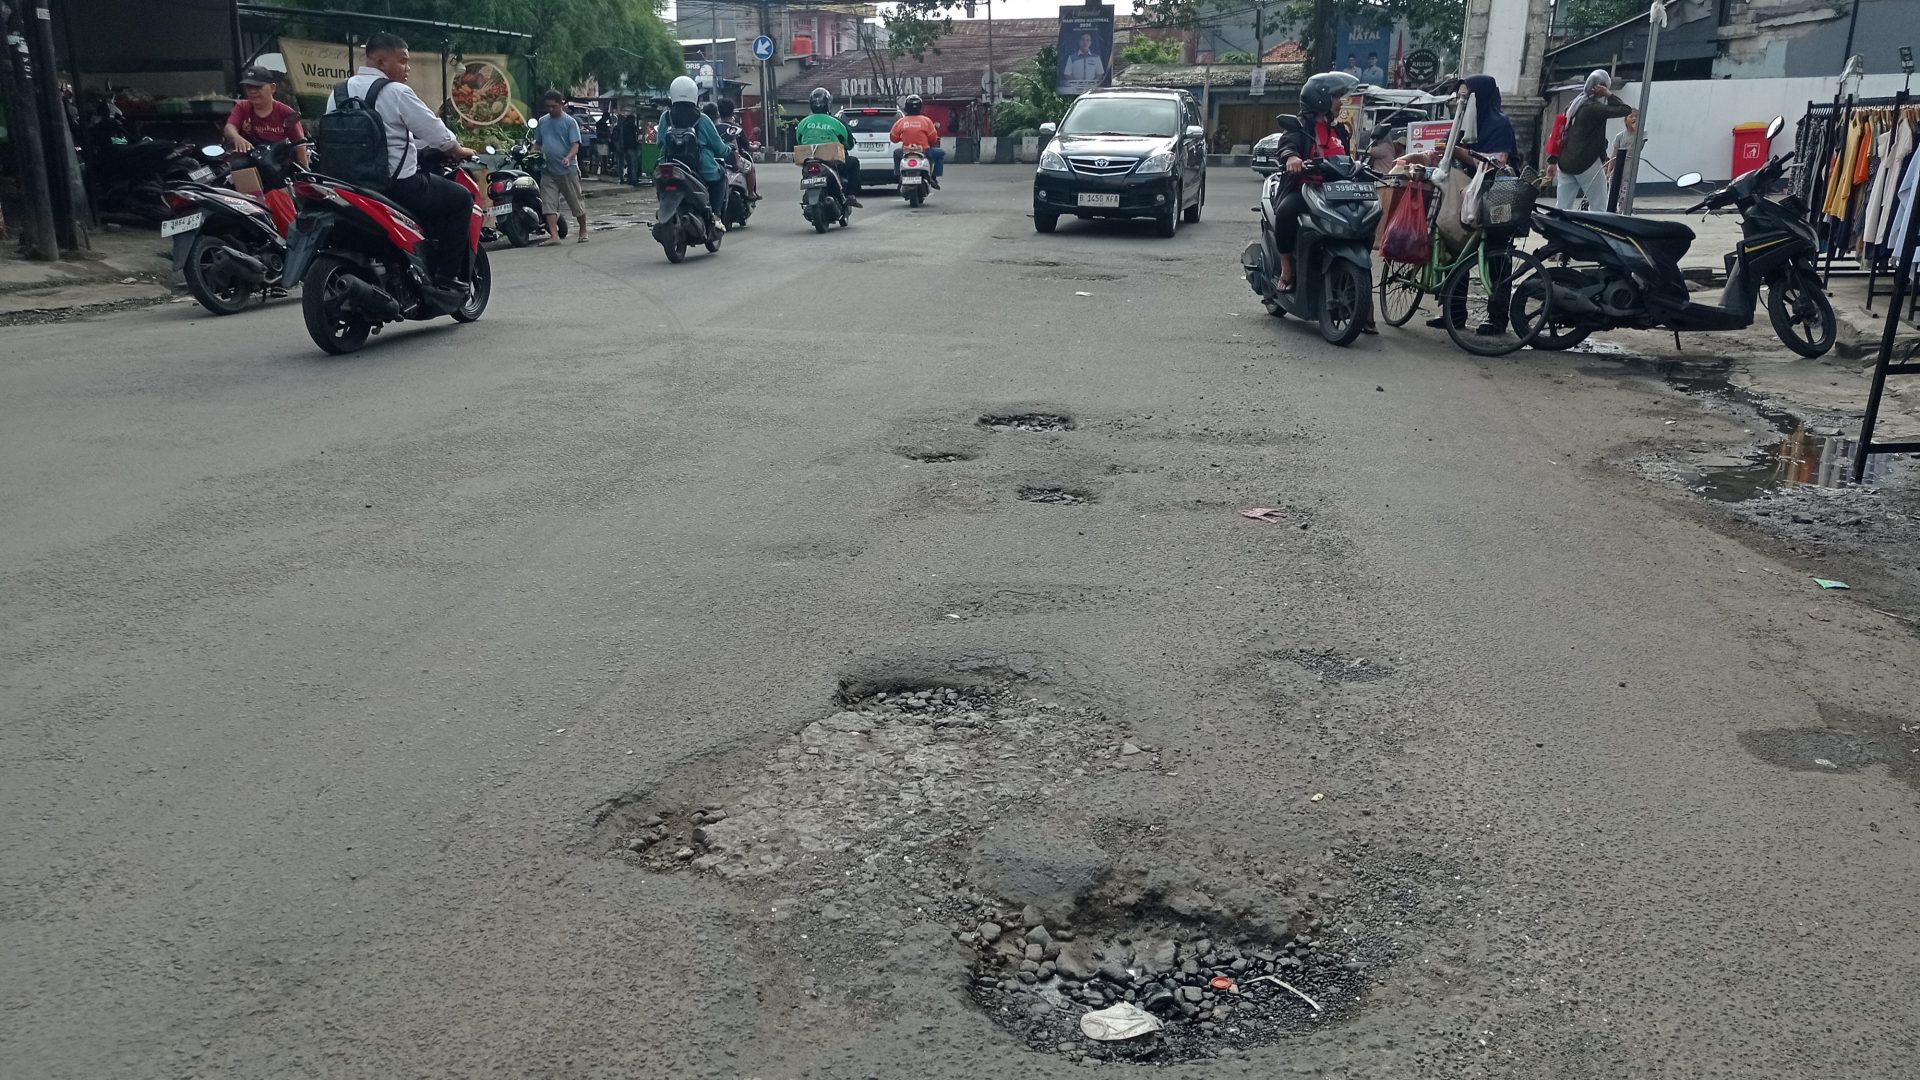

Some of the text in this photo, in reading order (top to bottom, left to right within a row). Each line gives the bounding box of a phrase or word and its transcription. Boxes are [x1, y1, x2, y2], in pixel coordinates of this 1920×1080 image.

[1348, 31, 1381, 41] NATAL
[306, 81, 325, 89] FRESH
[840, 78, 873, 96] ROTI
[927, 76, 943, 95] 88
[1087, 194, 1104, 203] 1450
